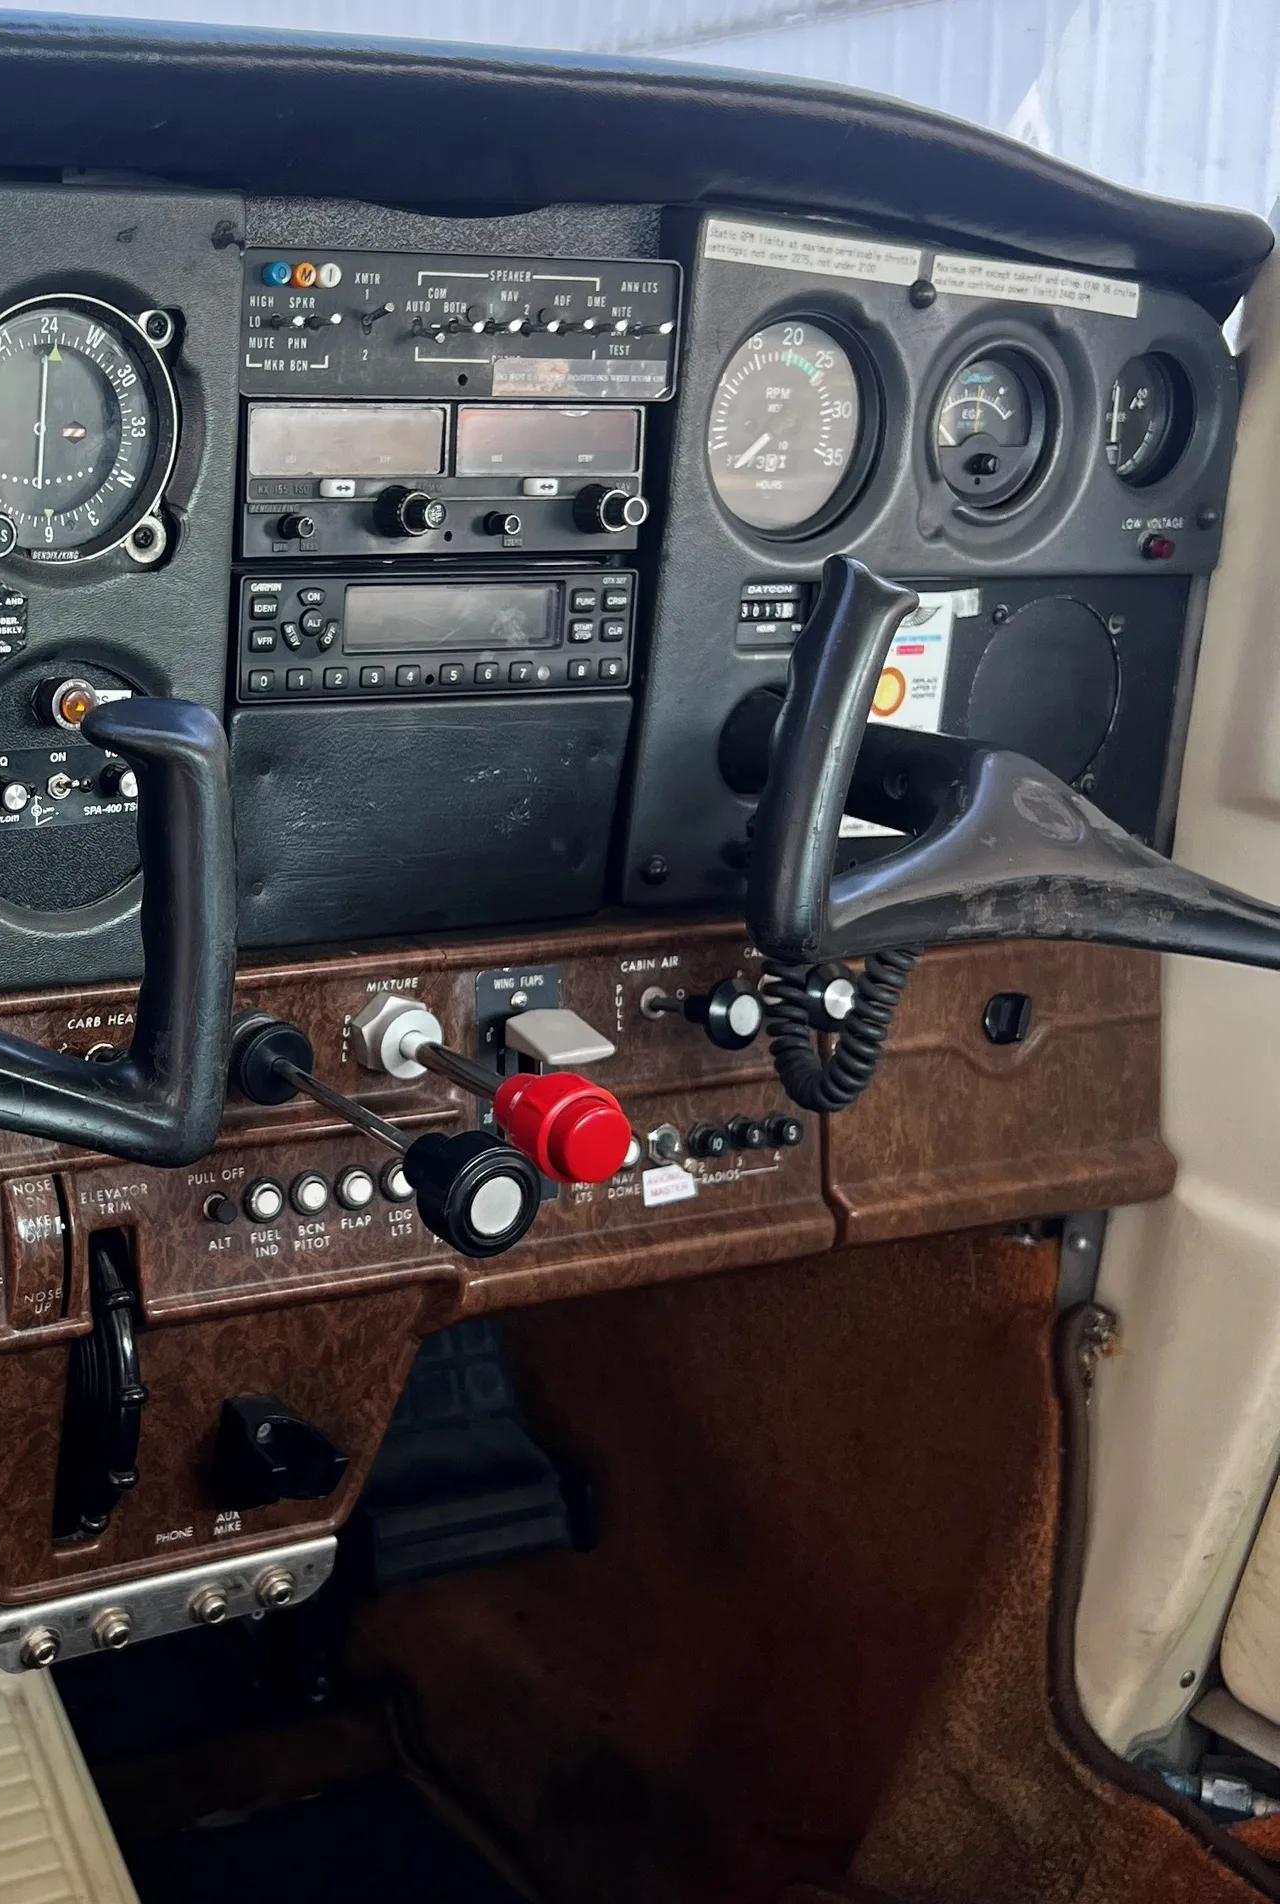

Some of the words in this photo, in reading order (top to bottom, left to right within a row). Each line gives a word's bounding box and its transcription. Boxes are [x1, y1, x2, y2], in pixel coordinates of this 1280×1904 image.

[355, 273, 380, 285] XMTR
[490, 270, 531, 282] SPEAKER
[428, 288, 447, 299] COM
[621, 282, 639, 292] ANN
[642, 283, 658, 293] LTS
[249, 296, 274, 307] HIGH
[289, 297, 315, 308] SPKR
[406, 301, 430, 312] AUTO
[612, 307, 632, 317] NITE
[41, 317, 58, 333] 24
[249, 337, 274, 349] MUTE
[783, 328, 804, 345] 20
[288, 338, 307, 349] PHN
[609, 345, 630, 355] TEST
[264, 360, 284, 370] MKR
[290, 360, 308, 370] BCN
[766, 388, 790, 399] RPM
[251, 583, 282, 591] GARMIN
[748, 586, 793, 594] DATCON
[308, 593, 320, 601] ON
[254, 604, 277, 612] IDENT
[608, 627, 622, 635] CLR
[257, 637, 272, 645] VFR
[50, 752, 67, 763] ON
[83, 803, 122, 816] SPA-400
[620, 959, 654, 973] CABIN
[661, 956, 678, 968] AIR
[366, 977, 418, 992] MIXTURE
[494, 977, 514, 990] WING
[520, 974, 544, 988] FLAPS
[68, 1017, 101, 1029] CARB
[108, 1013, 137, 1025] HEA
[188, 1172, 215, 1186] PULL
[222, 1167, 245, 1181] OFF
[702, 1169, 741, 1184] RADIOS
[12, 1180, 52, 1196] NOSE
[81, 1184, 148, 1204] ELEVATOR
[608, 1184, 641, 1199] DOME
[575, 1191, 593, 1203] LTS
[100, 1201, 131, 1215] TRIM
[388, 1208, 412, 1222] LDG
[298, 1221, 325, 1237] BCN
[341, 1215, 372, 1230] FLAP
[391, 1223, 412, 1237] LTS
[208, 1237, 231, 1251] ALT
[250, 1230, 281, 1245] FUEL
[294, 1235, 330, 1252] PITOT
[255, 1244, 279, 1258] IND
[24, 1288, 63, 1303] NOSE
[217, 1511, 240, 1522] AUX
[213, 1520, 242, 1536] MIKE
[156, 1526, 193, 1544] PHONE
